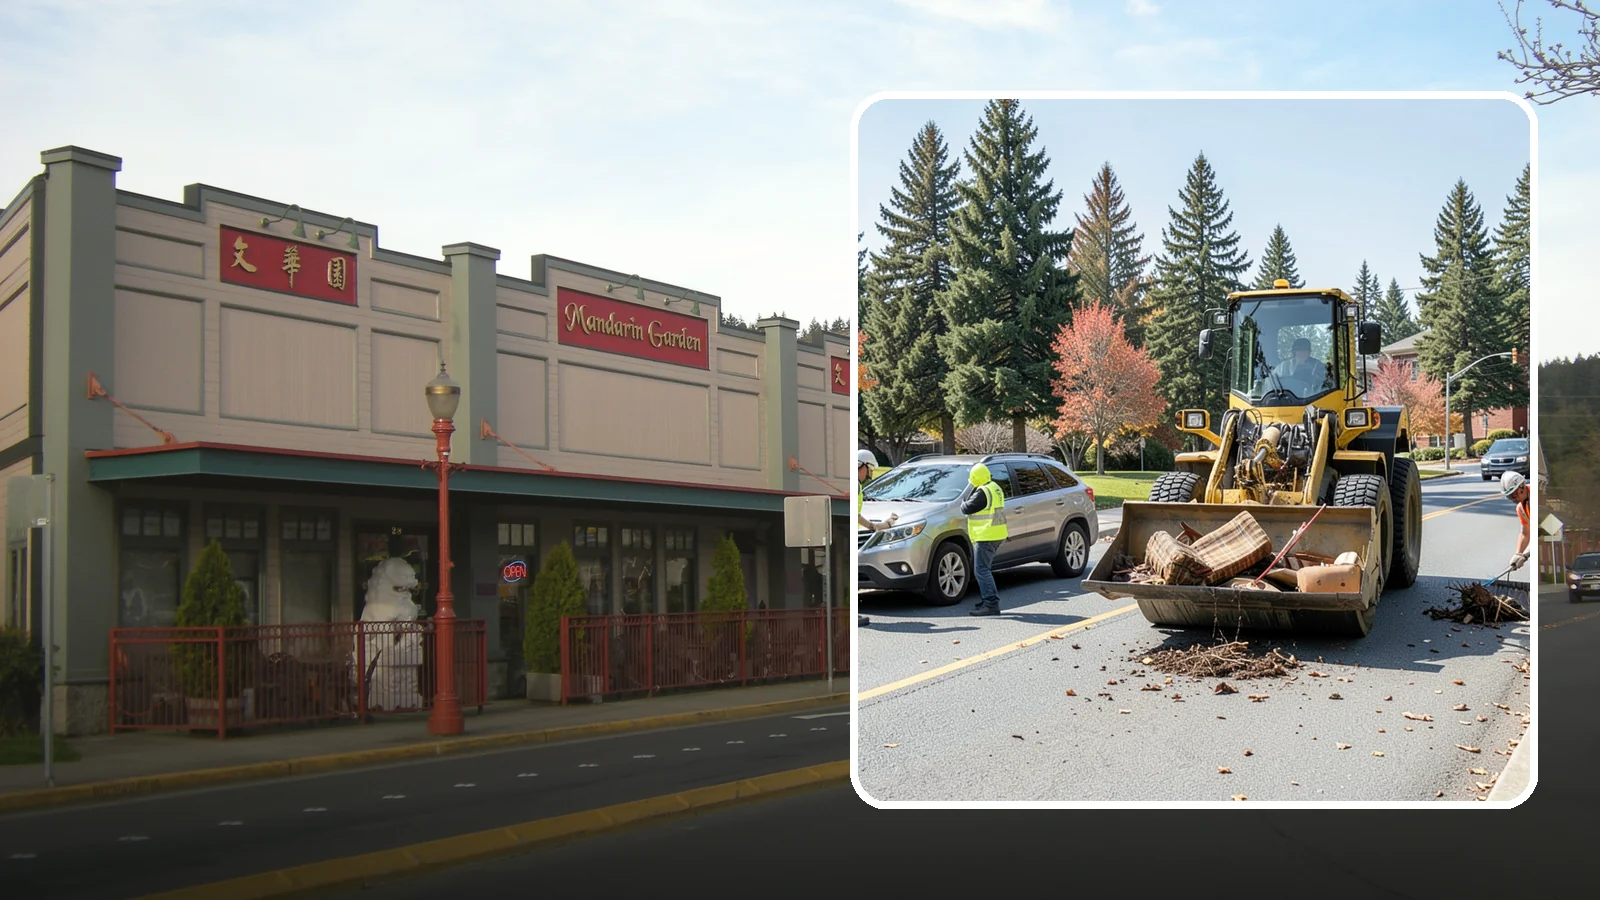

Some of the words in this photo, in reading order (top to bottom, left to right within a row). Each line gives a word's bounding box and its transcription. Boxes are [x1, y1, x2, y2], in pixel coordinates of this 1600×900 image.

[230, 235, 346, 291] 文華園
[564, 302, 645, 341] Mandarin
[647, 320, 702, 352] Garden
[503, 565, 527, 578] OPEN
